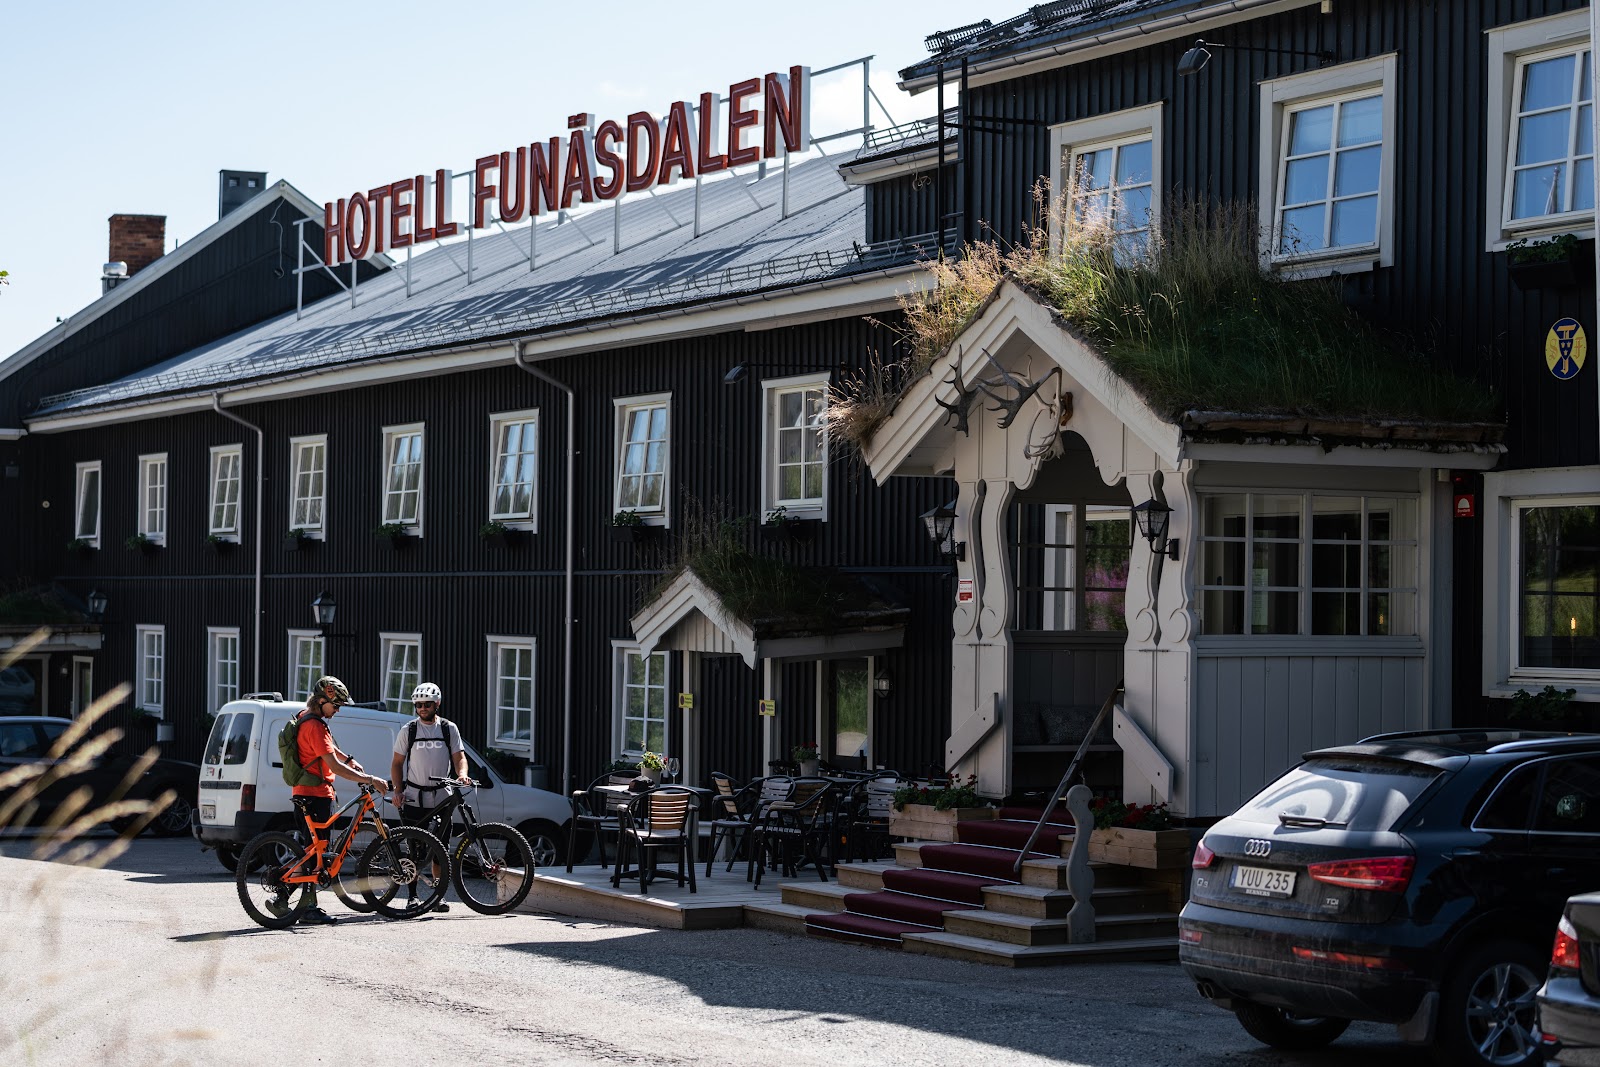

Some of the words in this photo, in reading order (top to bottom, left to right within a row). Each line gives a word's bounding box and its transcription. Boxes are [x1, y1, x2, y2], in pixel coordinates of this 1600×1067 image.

[325, 168, 463, 267] HOTELL
[475, 65, 810, 229] FUNÄSDALEN
[1240, 868, 1264, 888] YUU
[1265, 872, 1290, 891] 235
